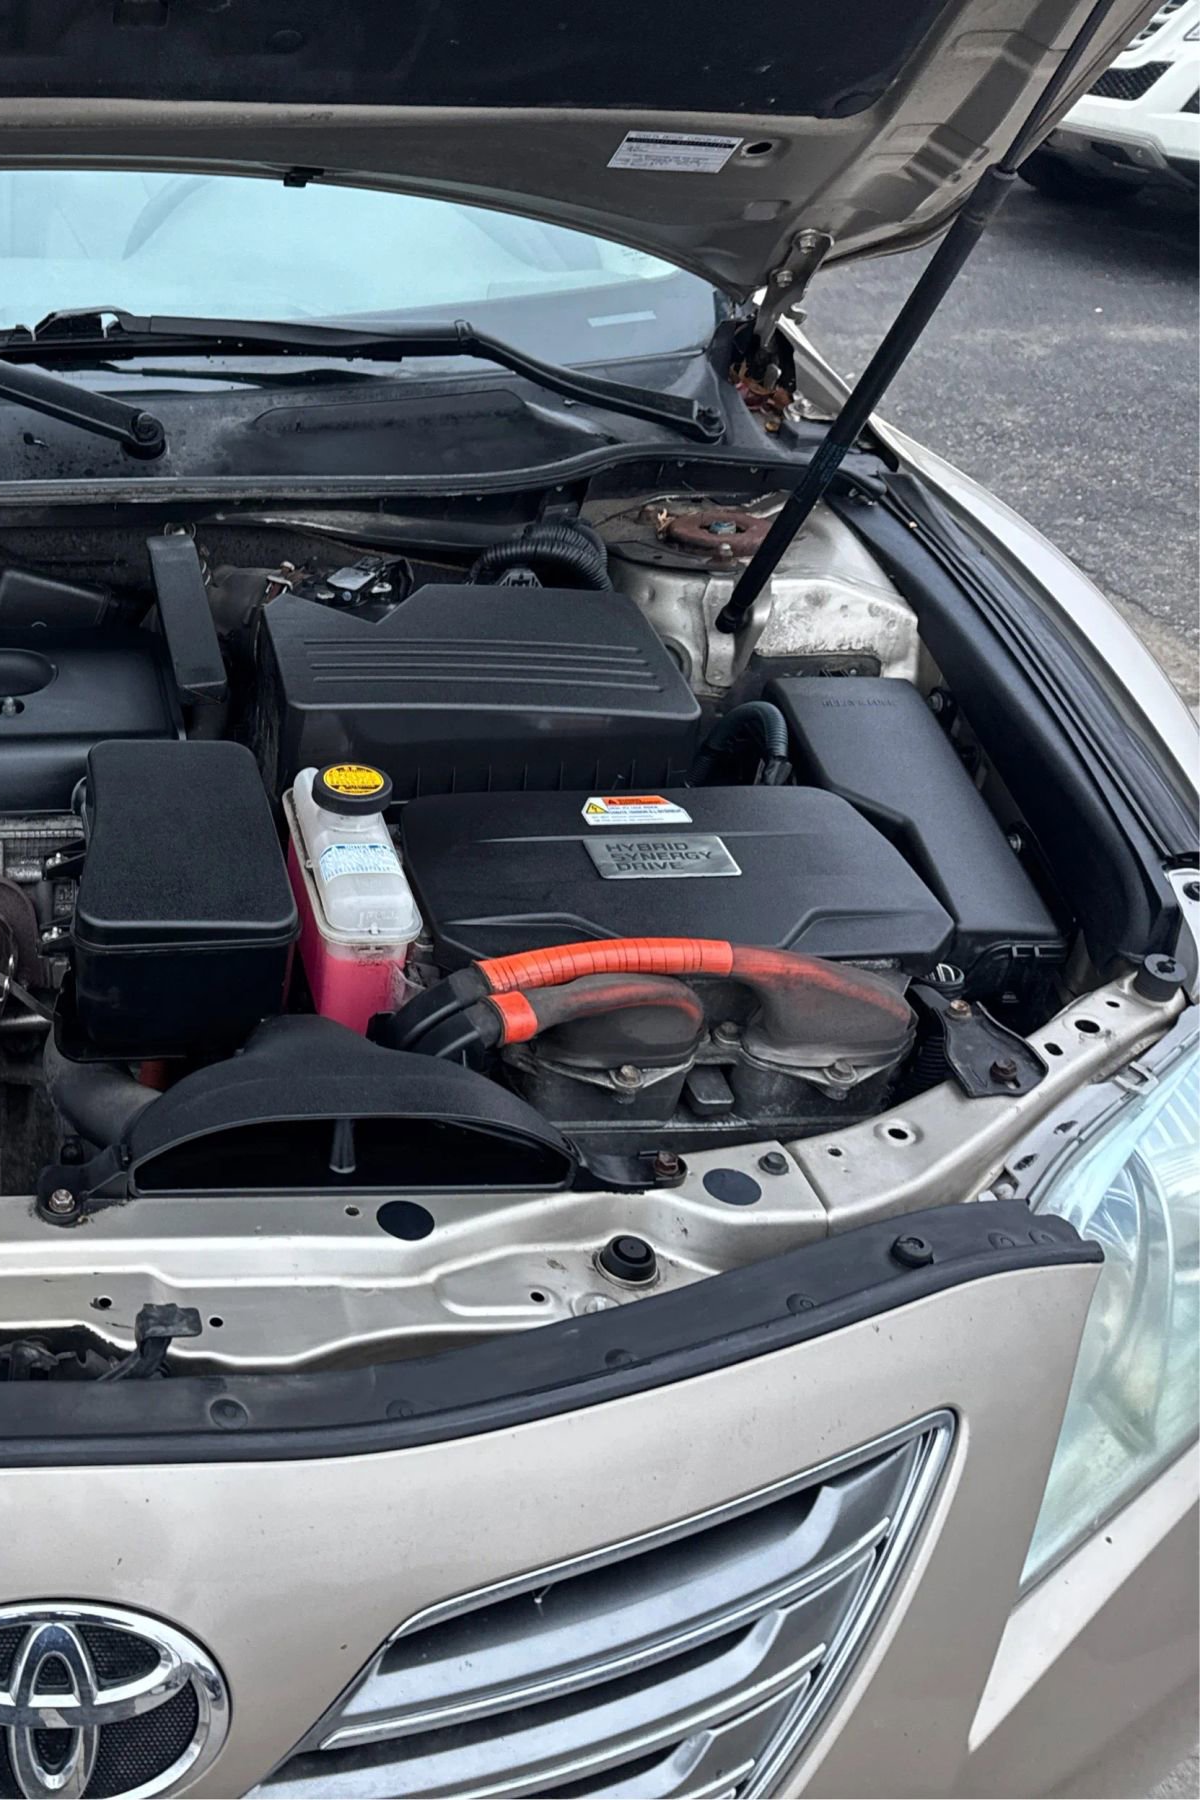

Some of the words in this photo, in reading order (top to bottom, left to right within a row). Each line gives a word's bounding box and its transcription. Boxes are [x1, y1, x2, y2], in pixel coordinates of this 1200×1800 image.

[605, 842, 689, 852] HYBRID
[610, 851, 713, 862] SYNERGY
[616, 861, 685, 872] DRIVE
